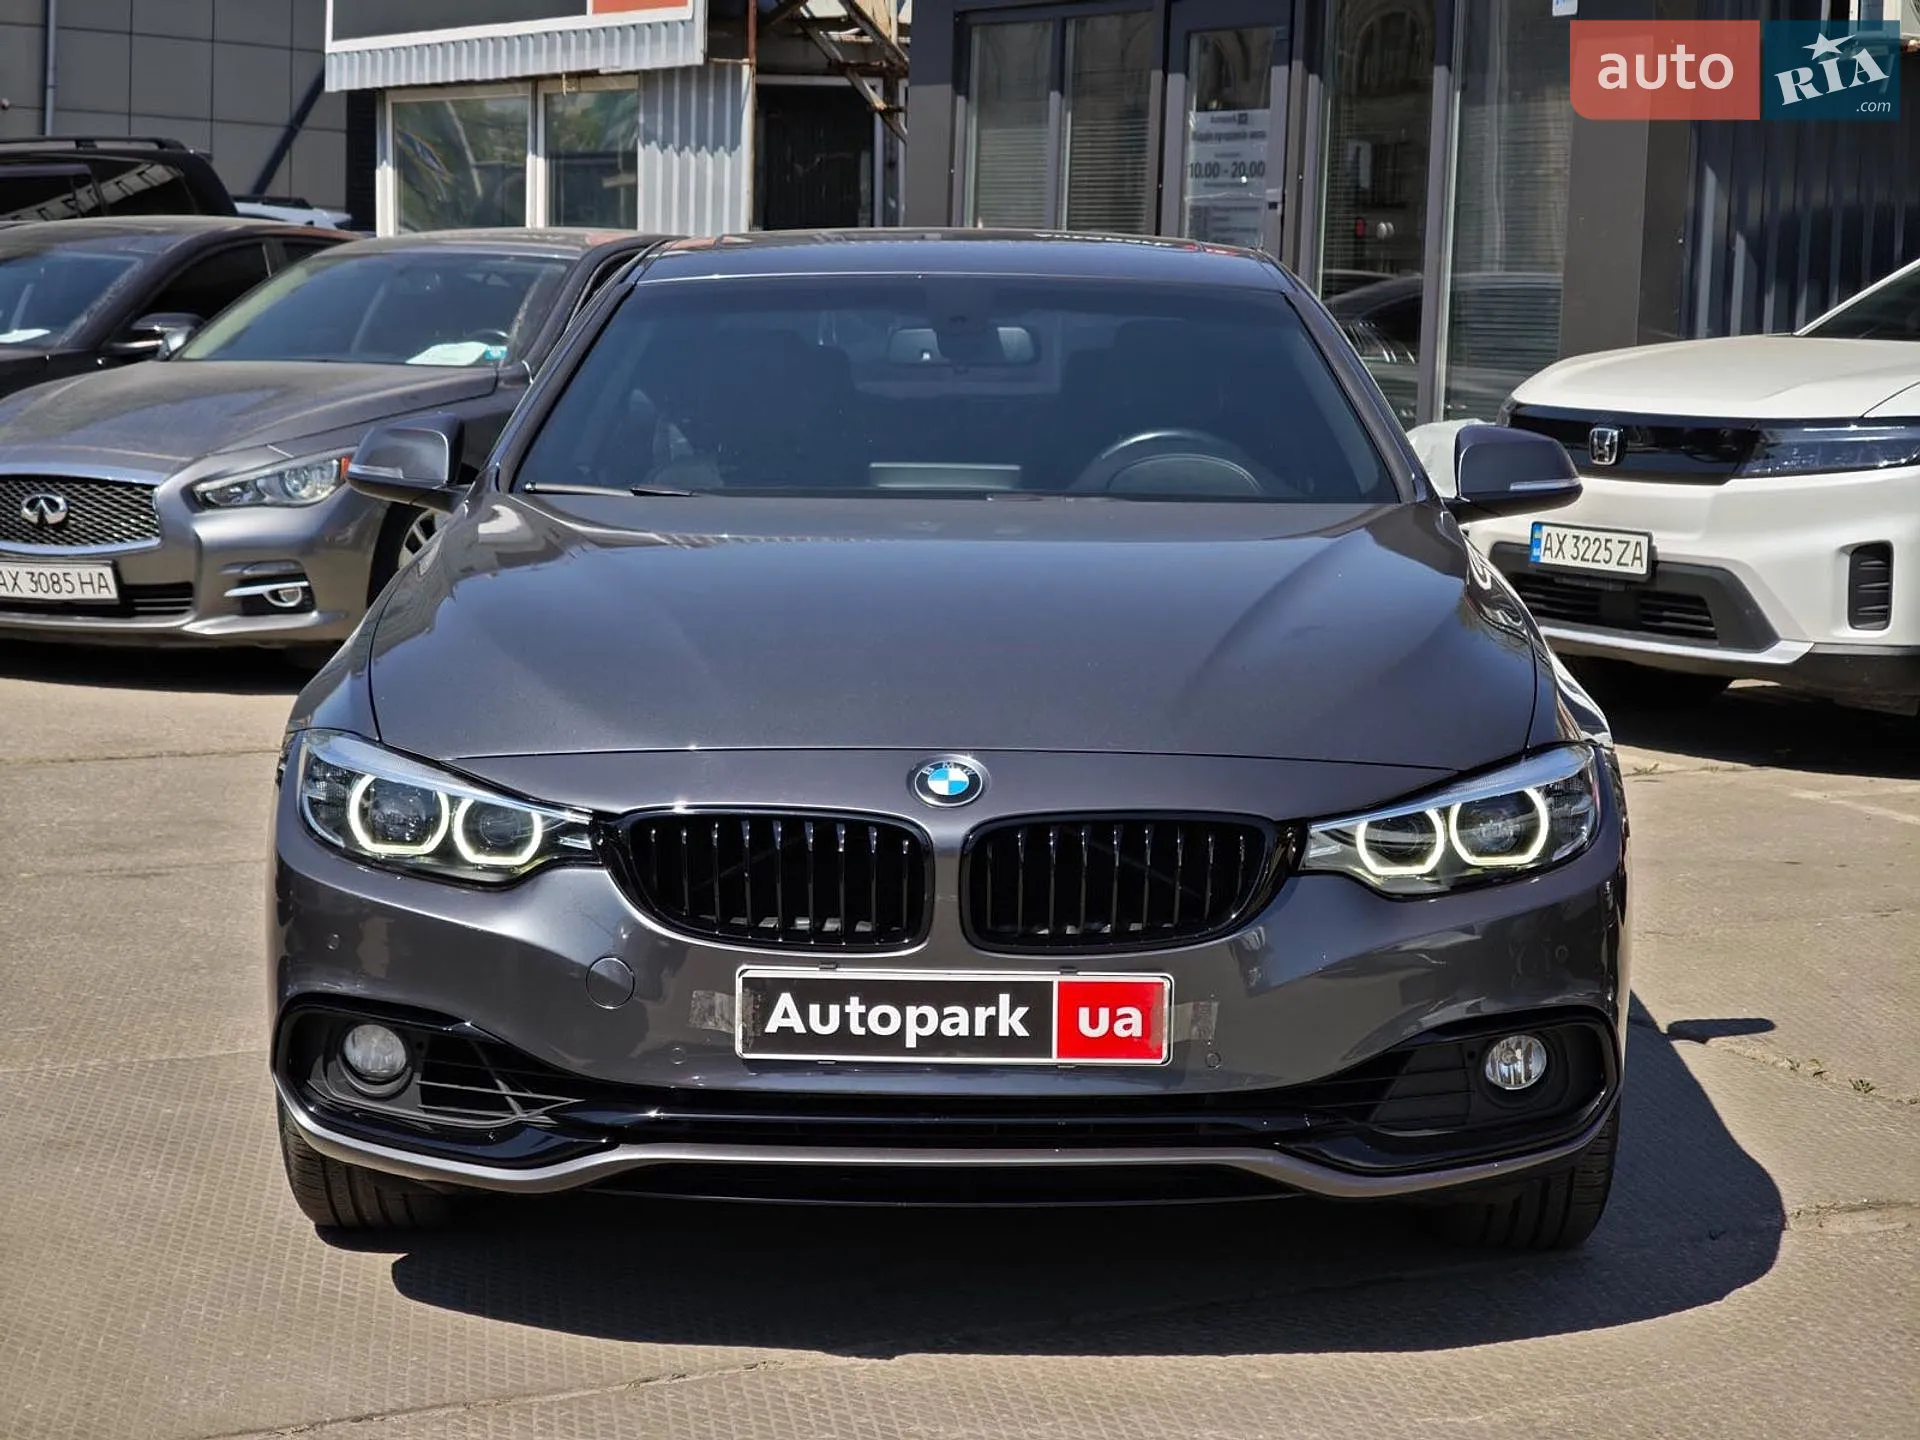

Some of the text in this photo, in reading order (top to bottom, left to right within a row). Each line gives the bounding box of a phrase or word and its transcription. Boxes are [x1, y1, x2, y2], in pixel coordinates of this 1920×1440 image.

[1190, 161, 1220, 178] 10.00
[1231, 160, 1266, 178] 20.00
[1543, 532, 1644, 568] AX 3225 ZA
[25, 571, 75, 594] 3085
[77, 572, 111, 594] HA
[765, 992, 1143, 1048] Autopark ua
